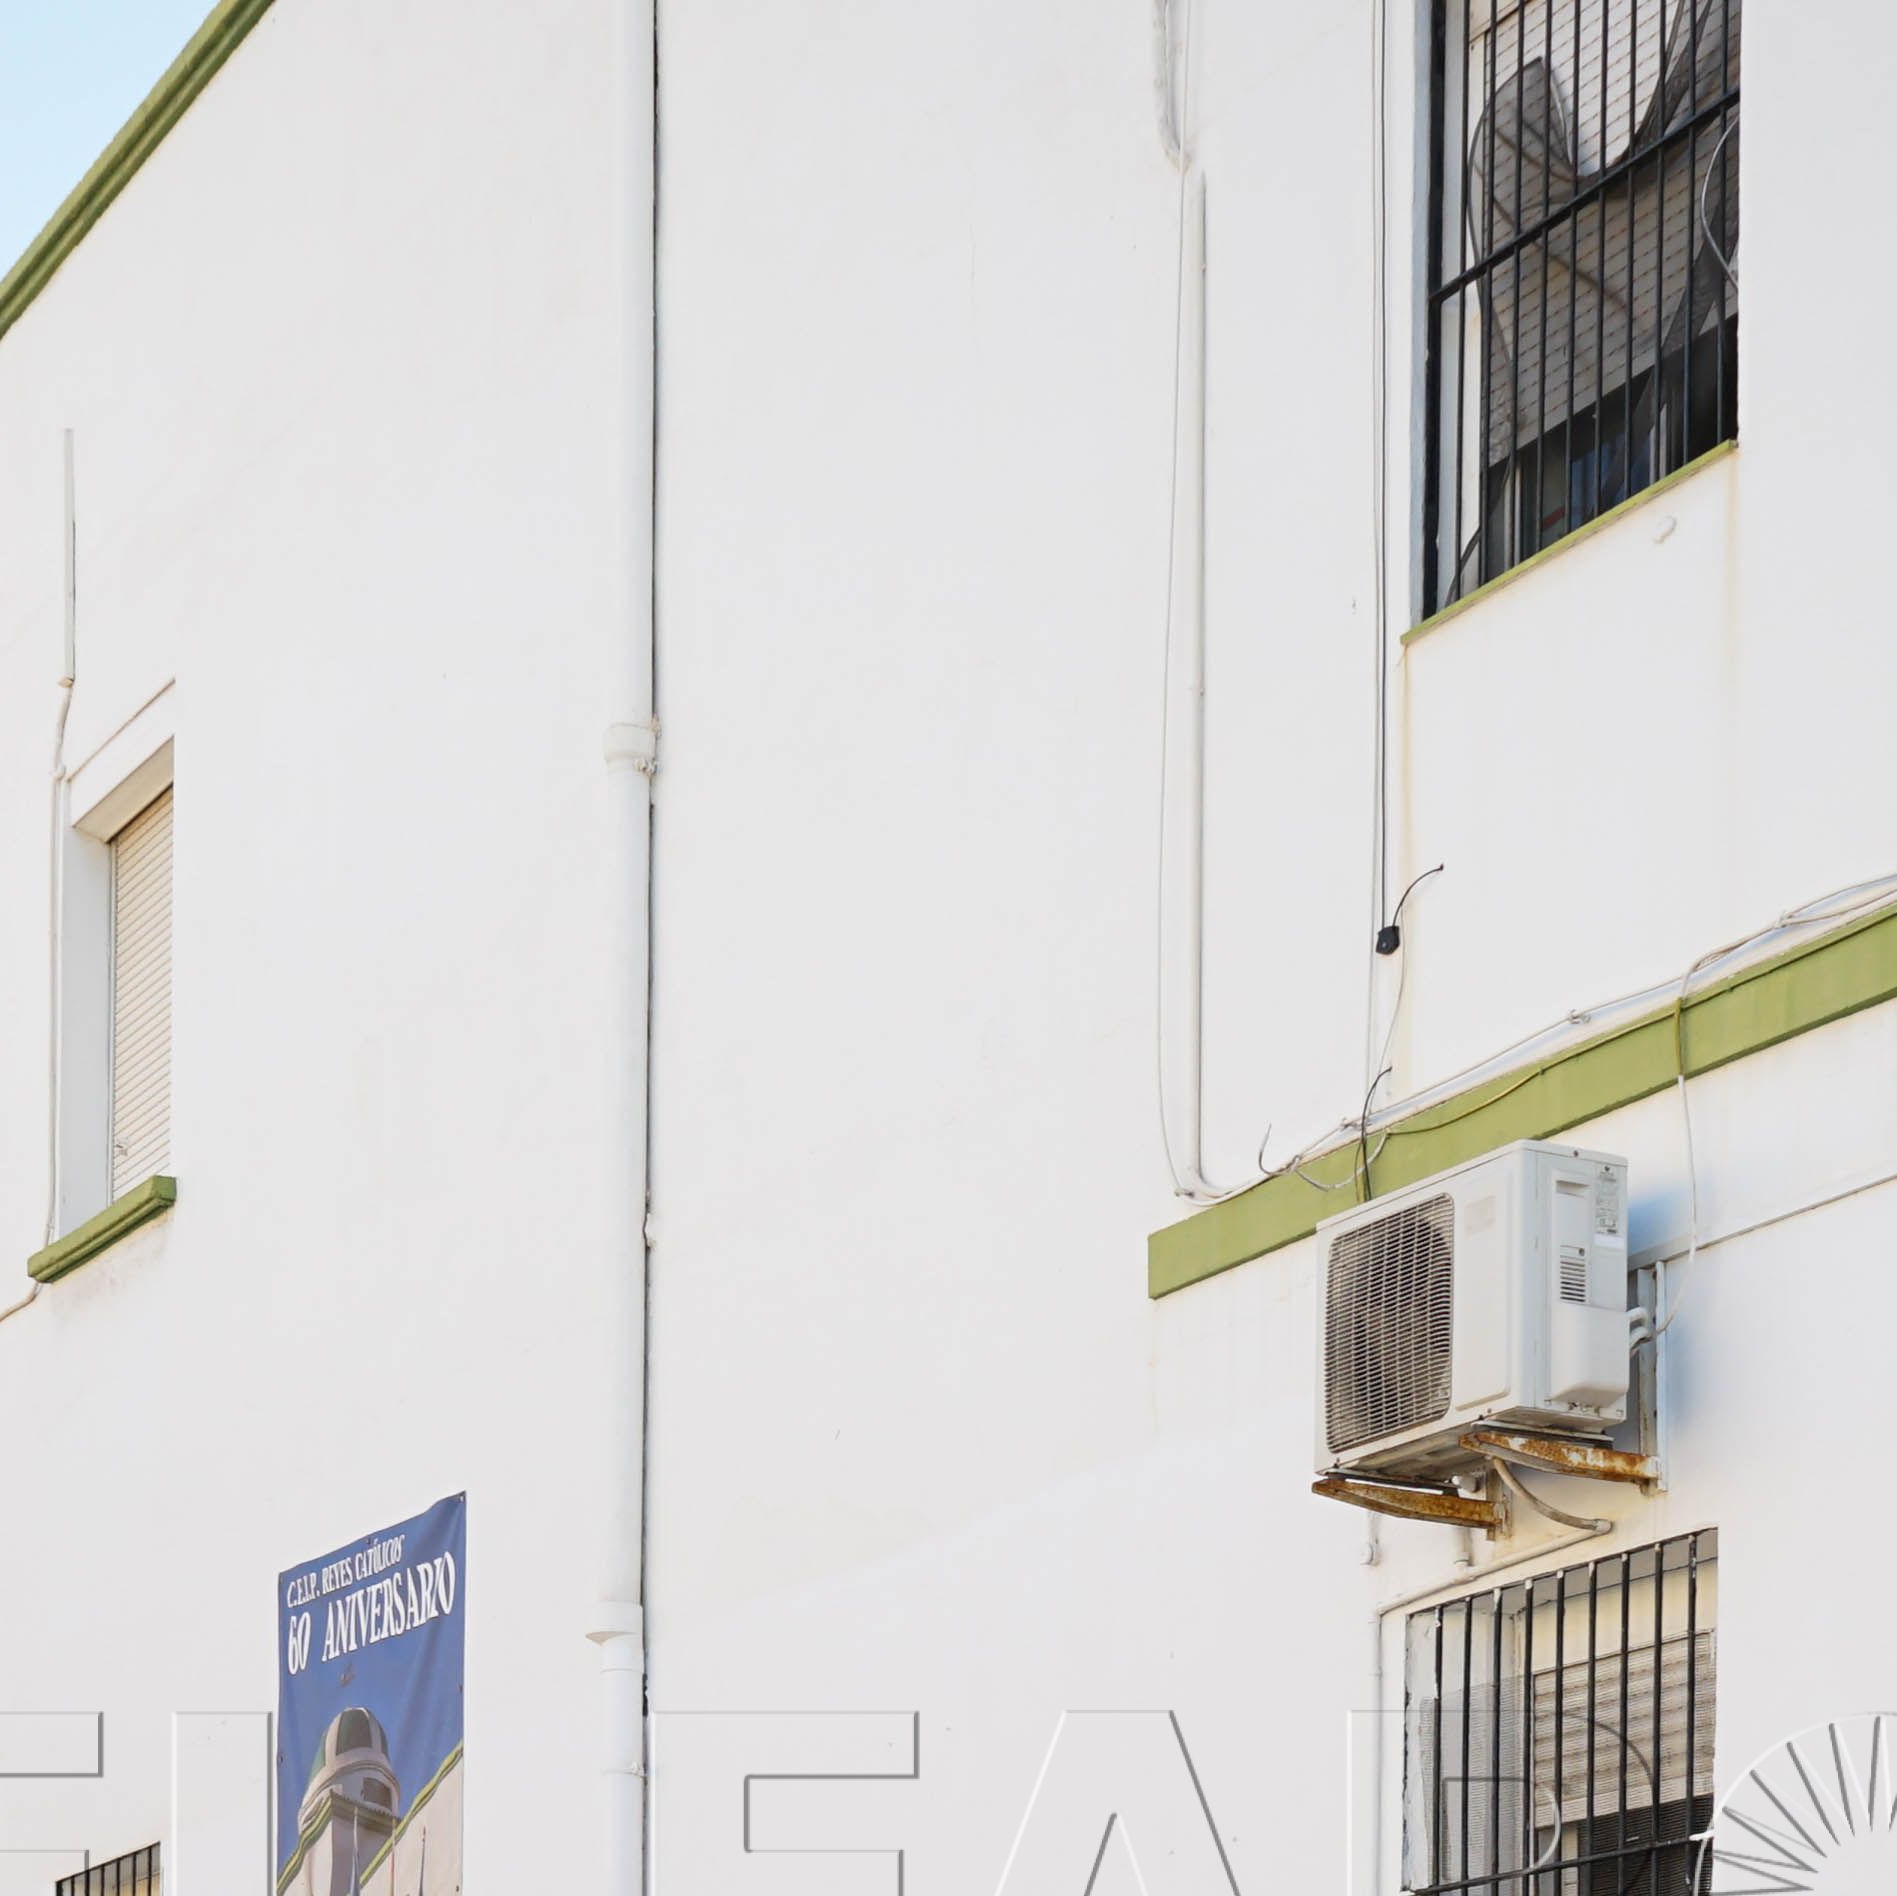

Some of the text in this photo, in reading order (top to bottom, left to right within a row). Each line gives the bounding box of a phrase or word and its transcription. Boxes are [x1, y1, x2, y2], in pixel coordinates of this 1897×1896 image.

[287, 1534, 405, 1608] C.E.I.P. REYES CATÓLICOS
[288, 1551, 456, 1675] 60 ANIVERSARIO
